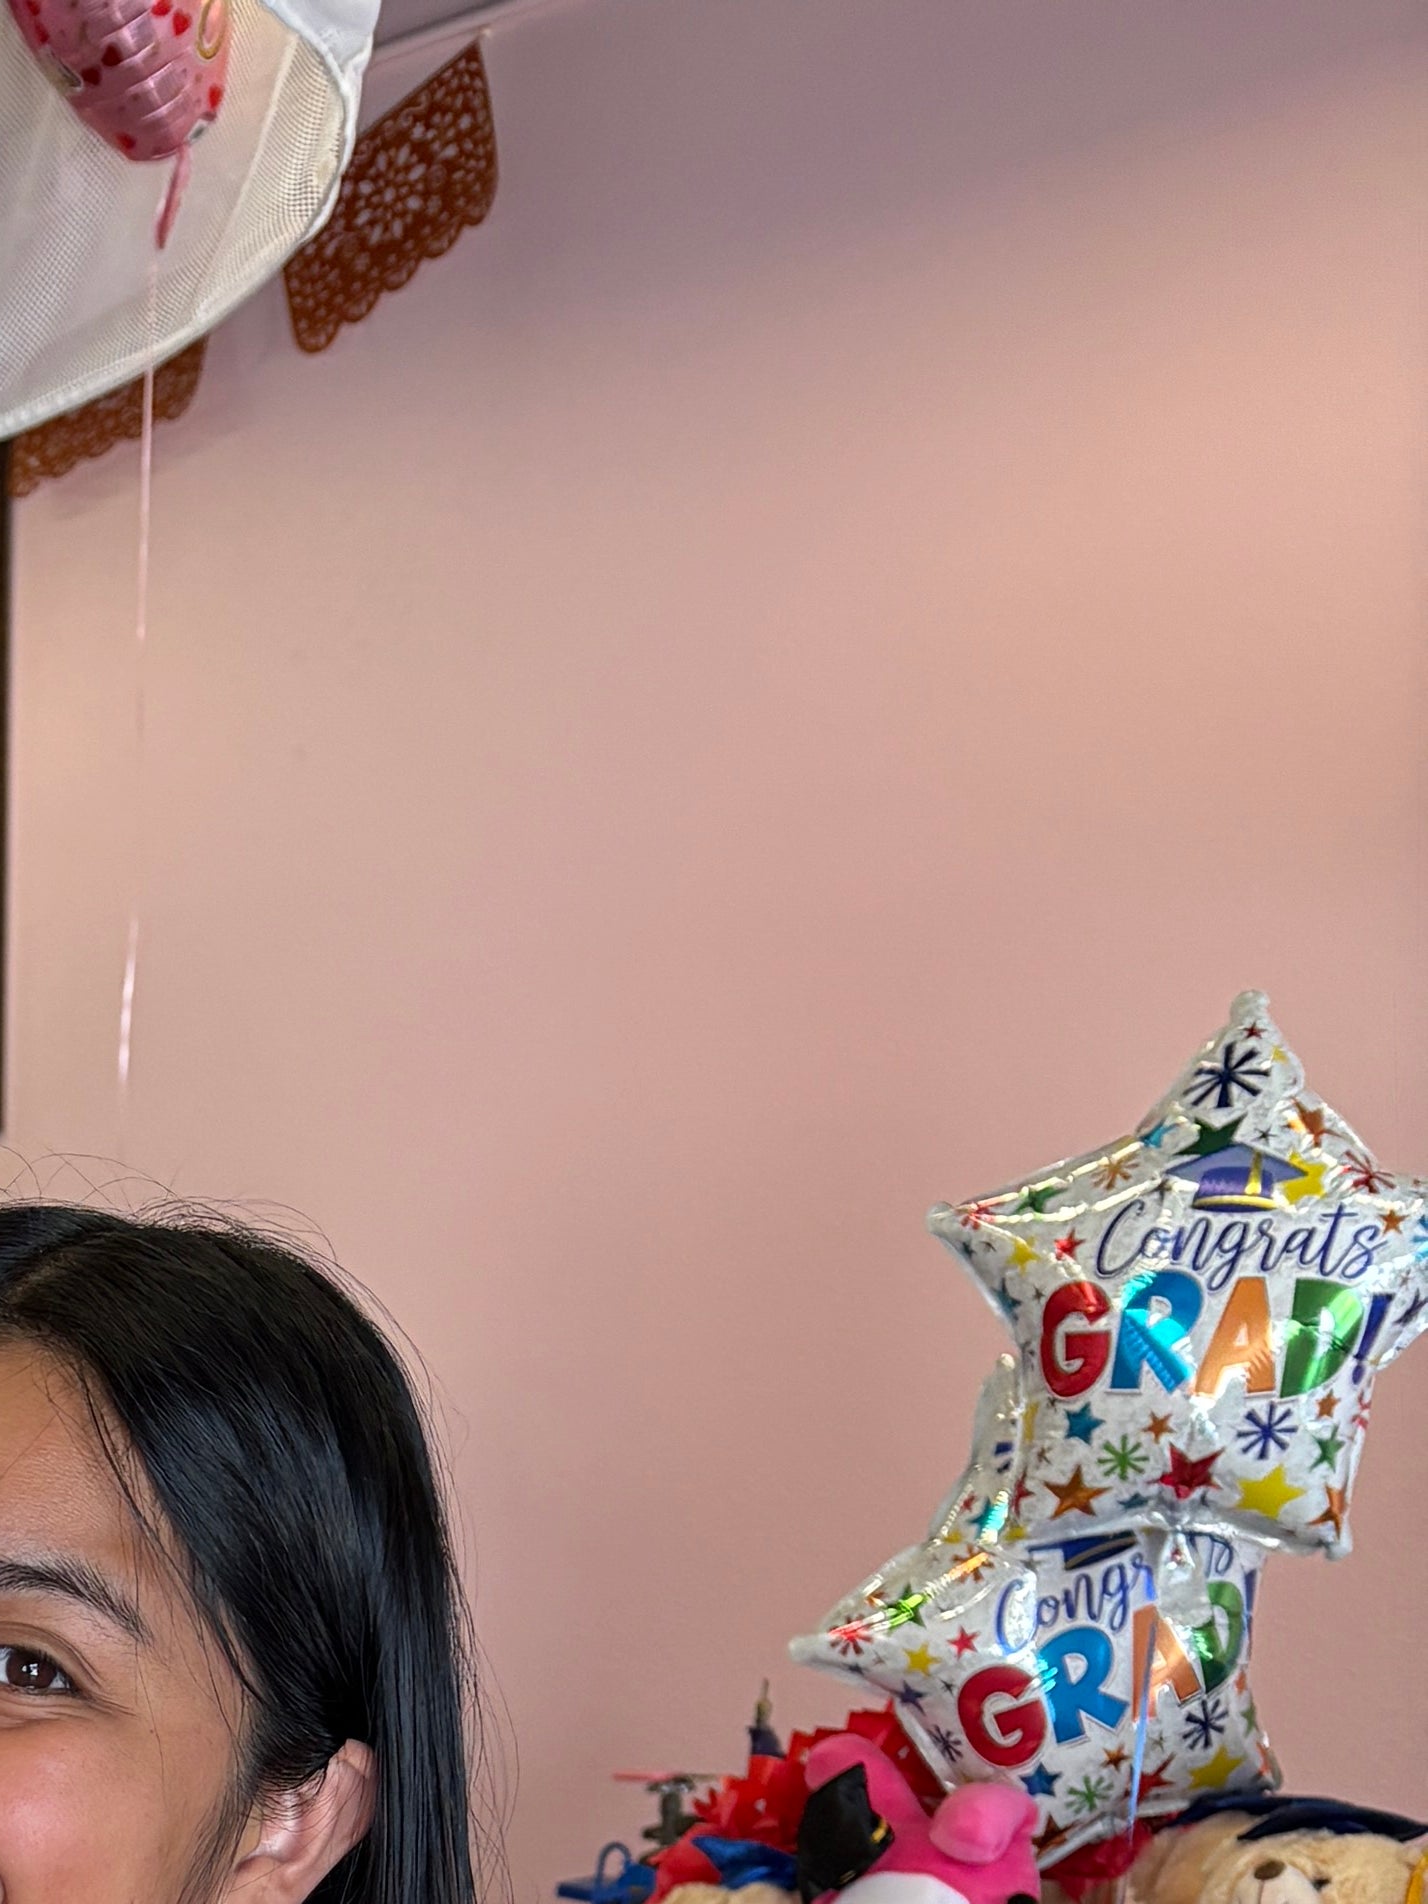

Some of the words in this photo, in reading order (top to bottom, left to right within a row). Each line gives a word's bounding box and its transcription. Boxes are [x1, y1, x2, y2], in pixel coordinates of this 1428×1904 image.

[1096, 1200, 1391, 1292] Congrats
[1040, 1268, 1394, 1399] GRAD!
[996, 1530, 1234, 1655] Congrs
